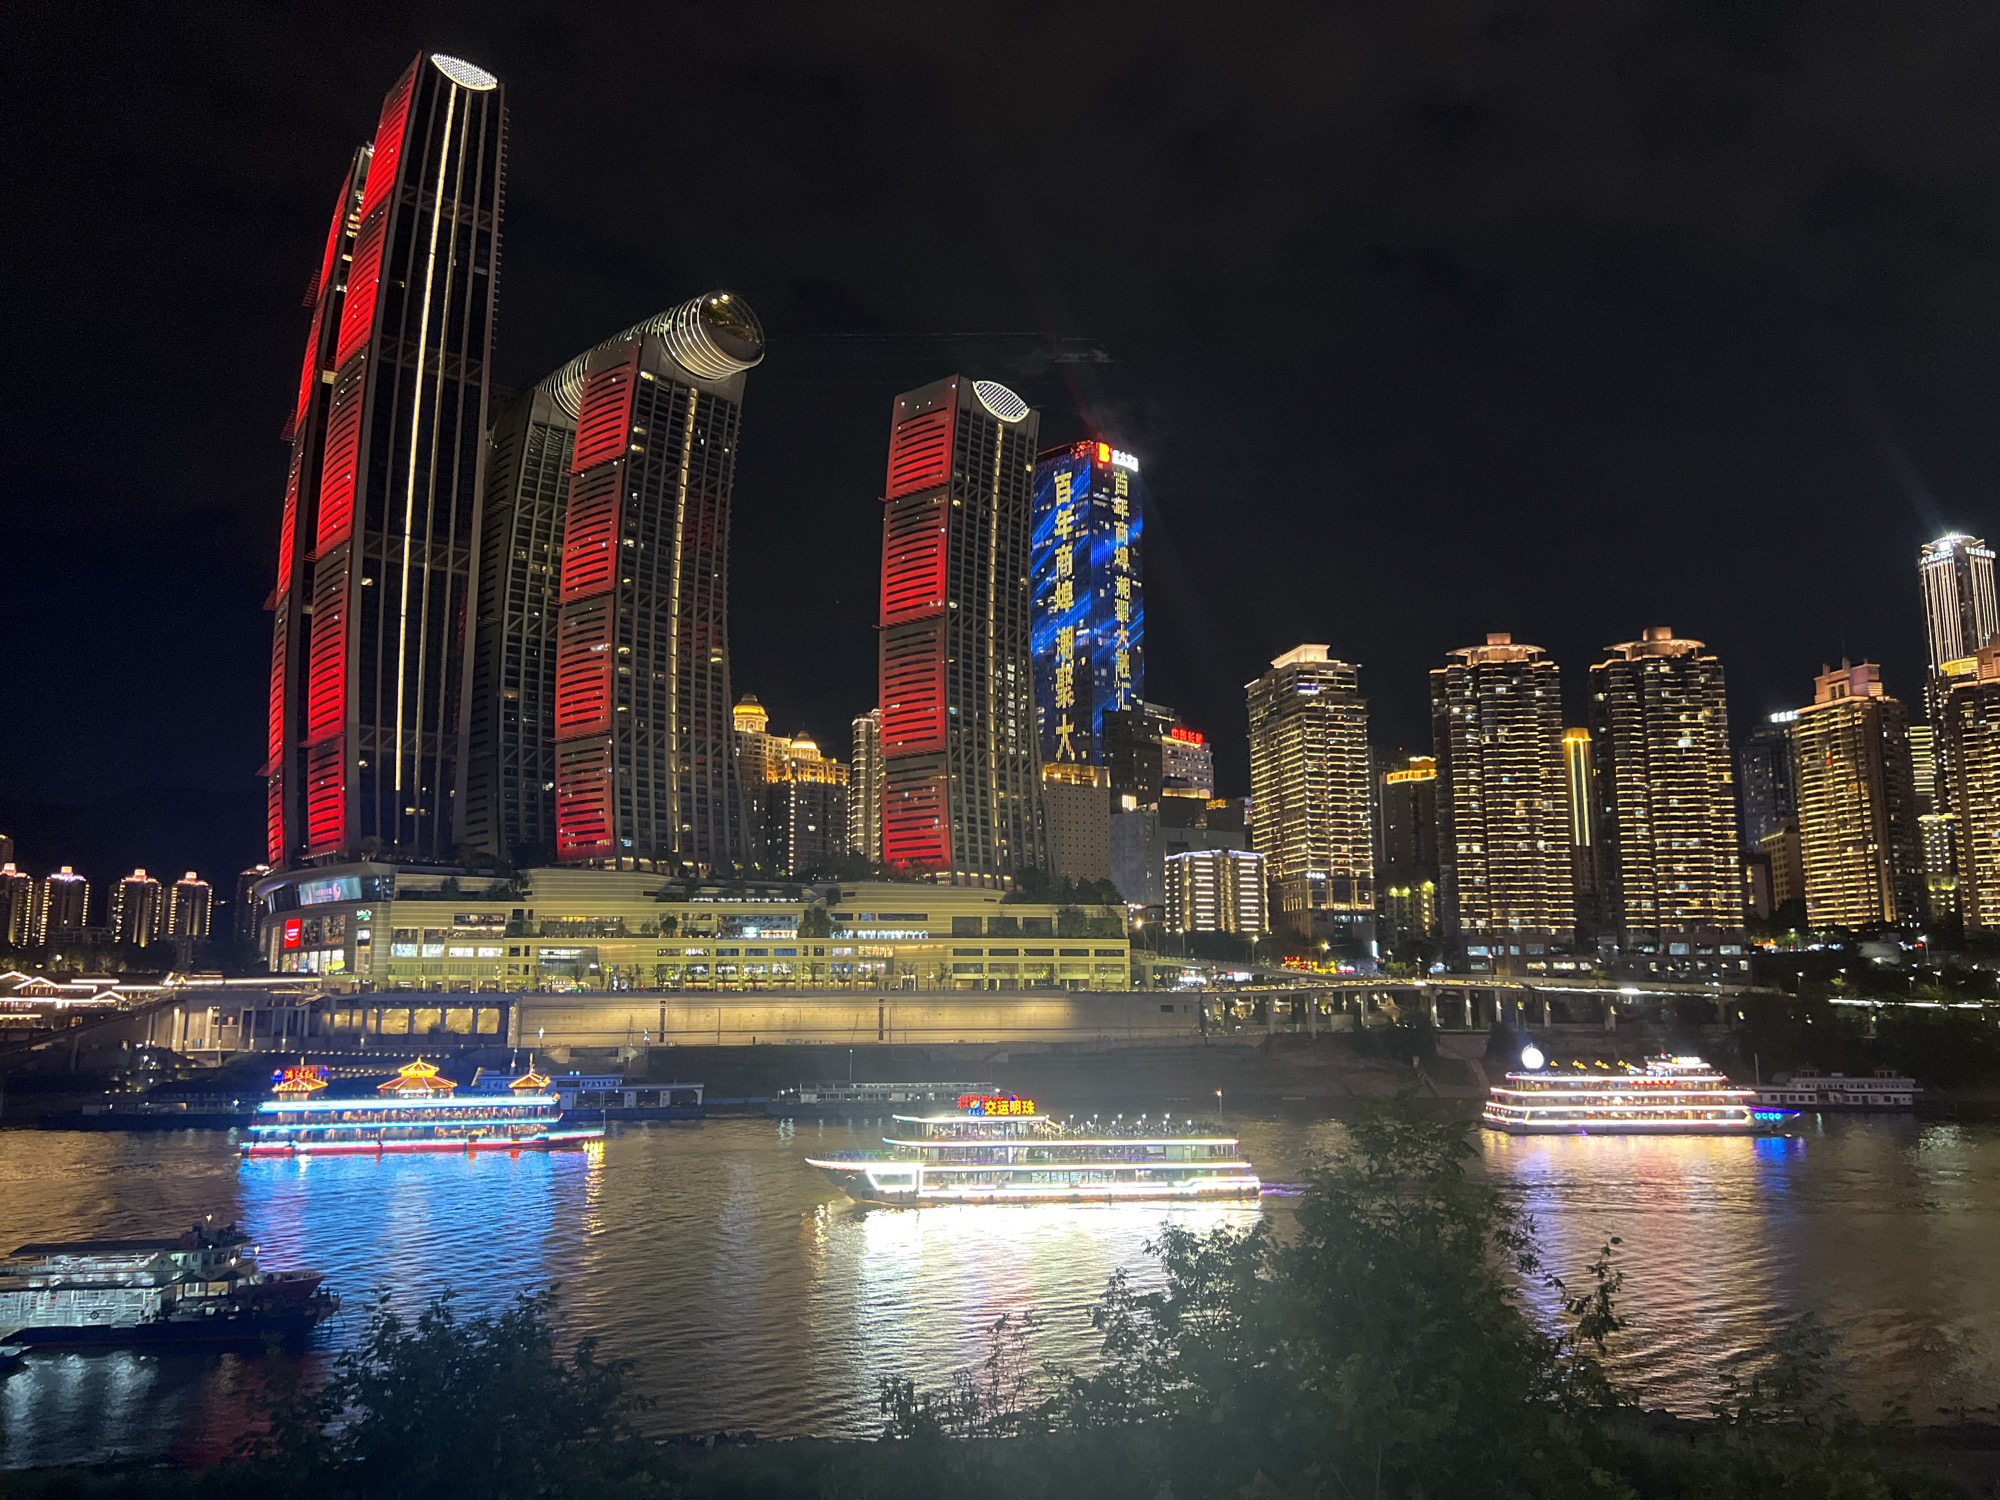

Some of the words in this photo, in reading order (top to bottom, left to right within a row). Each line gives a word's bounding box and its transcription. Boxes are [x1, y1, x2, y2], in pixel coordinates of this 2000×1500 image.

[1054, 472, 1074, 613] 百年商埠
[1114, 471, 1129, 572] 百年商埠
[985, 1100, 1035, 1116] 交运明珠
